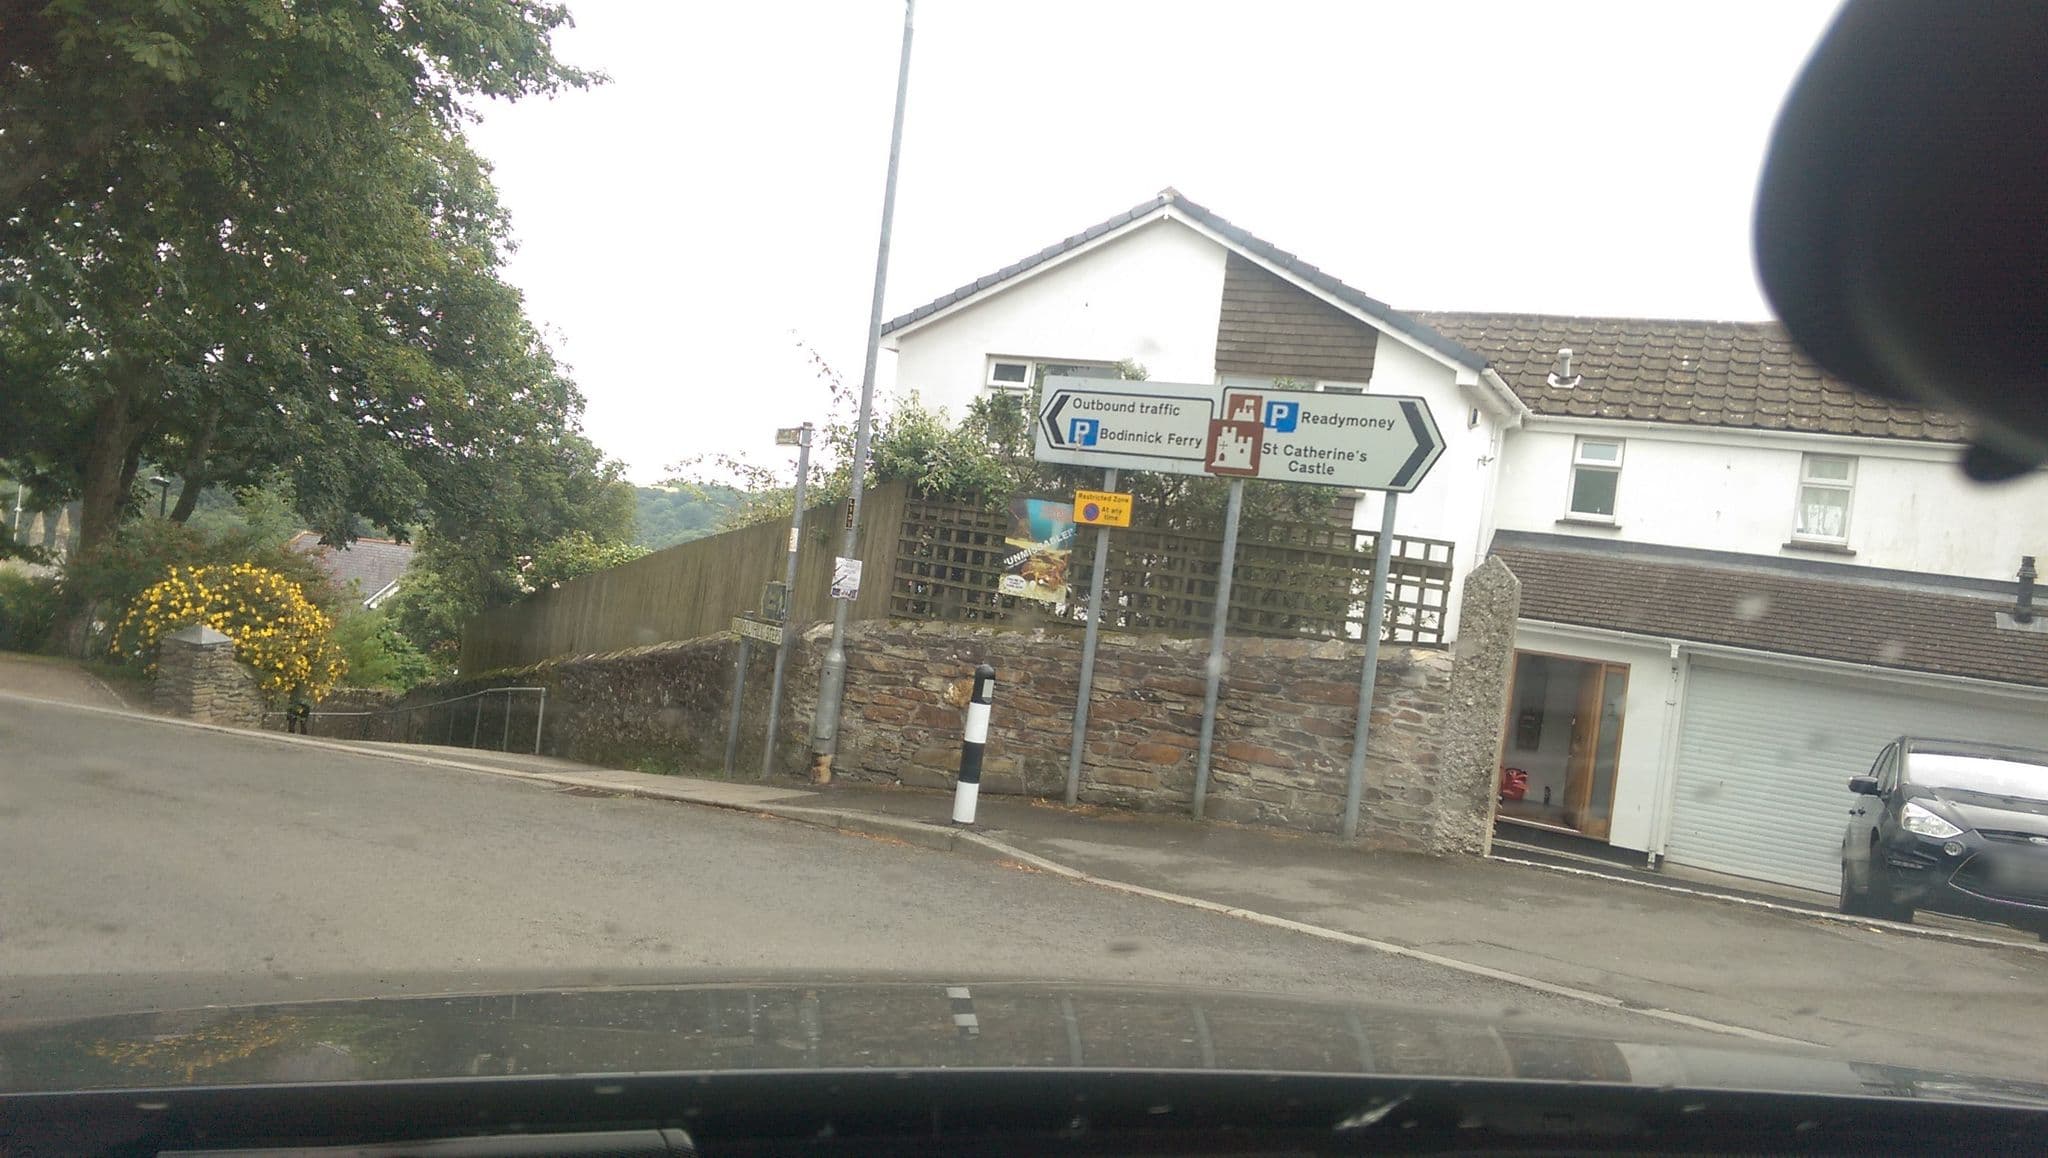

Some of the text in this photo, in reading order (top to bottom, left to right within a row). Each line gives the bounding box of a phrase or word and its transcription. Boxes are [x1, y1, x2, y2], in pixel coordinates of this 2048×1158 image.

[1073, 397, 1181, 416] Outbound traffic
[1270, 405, 1289, 427] P
[1301, 411, 1396, 431] Readymoney
[1100, 428, 1203, 449] Bodinnick Ferry
[1262, 442, 1368, 462] St Catherine's
[1288, 461, 1335, 475] Castle
[1078, 492, 1129, 503] Restricted Zone
